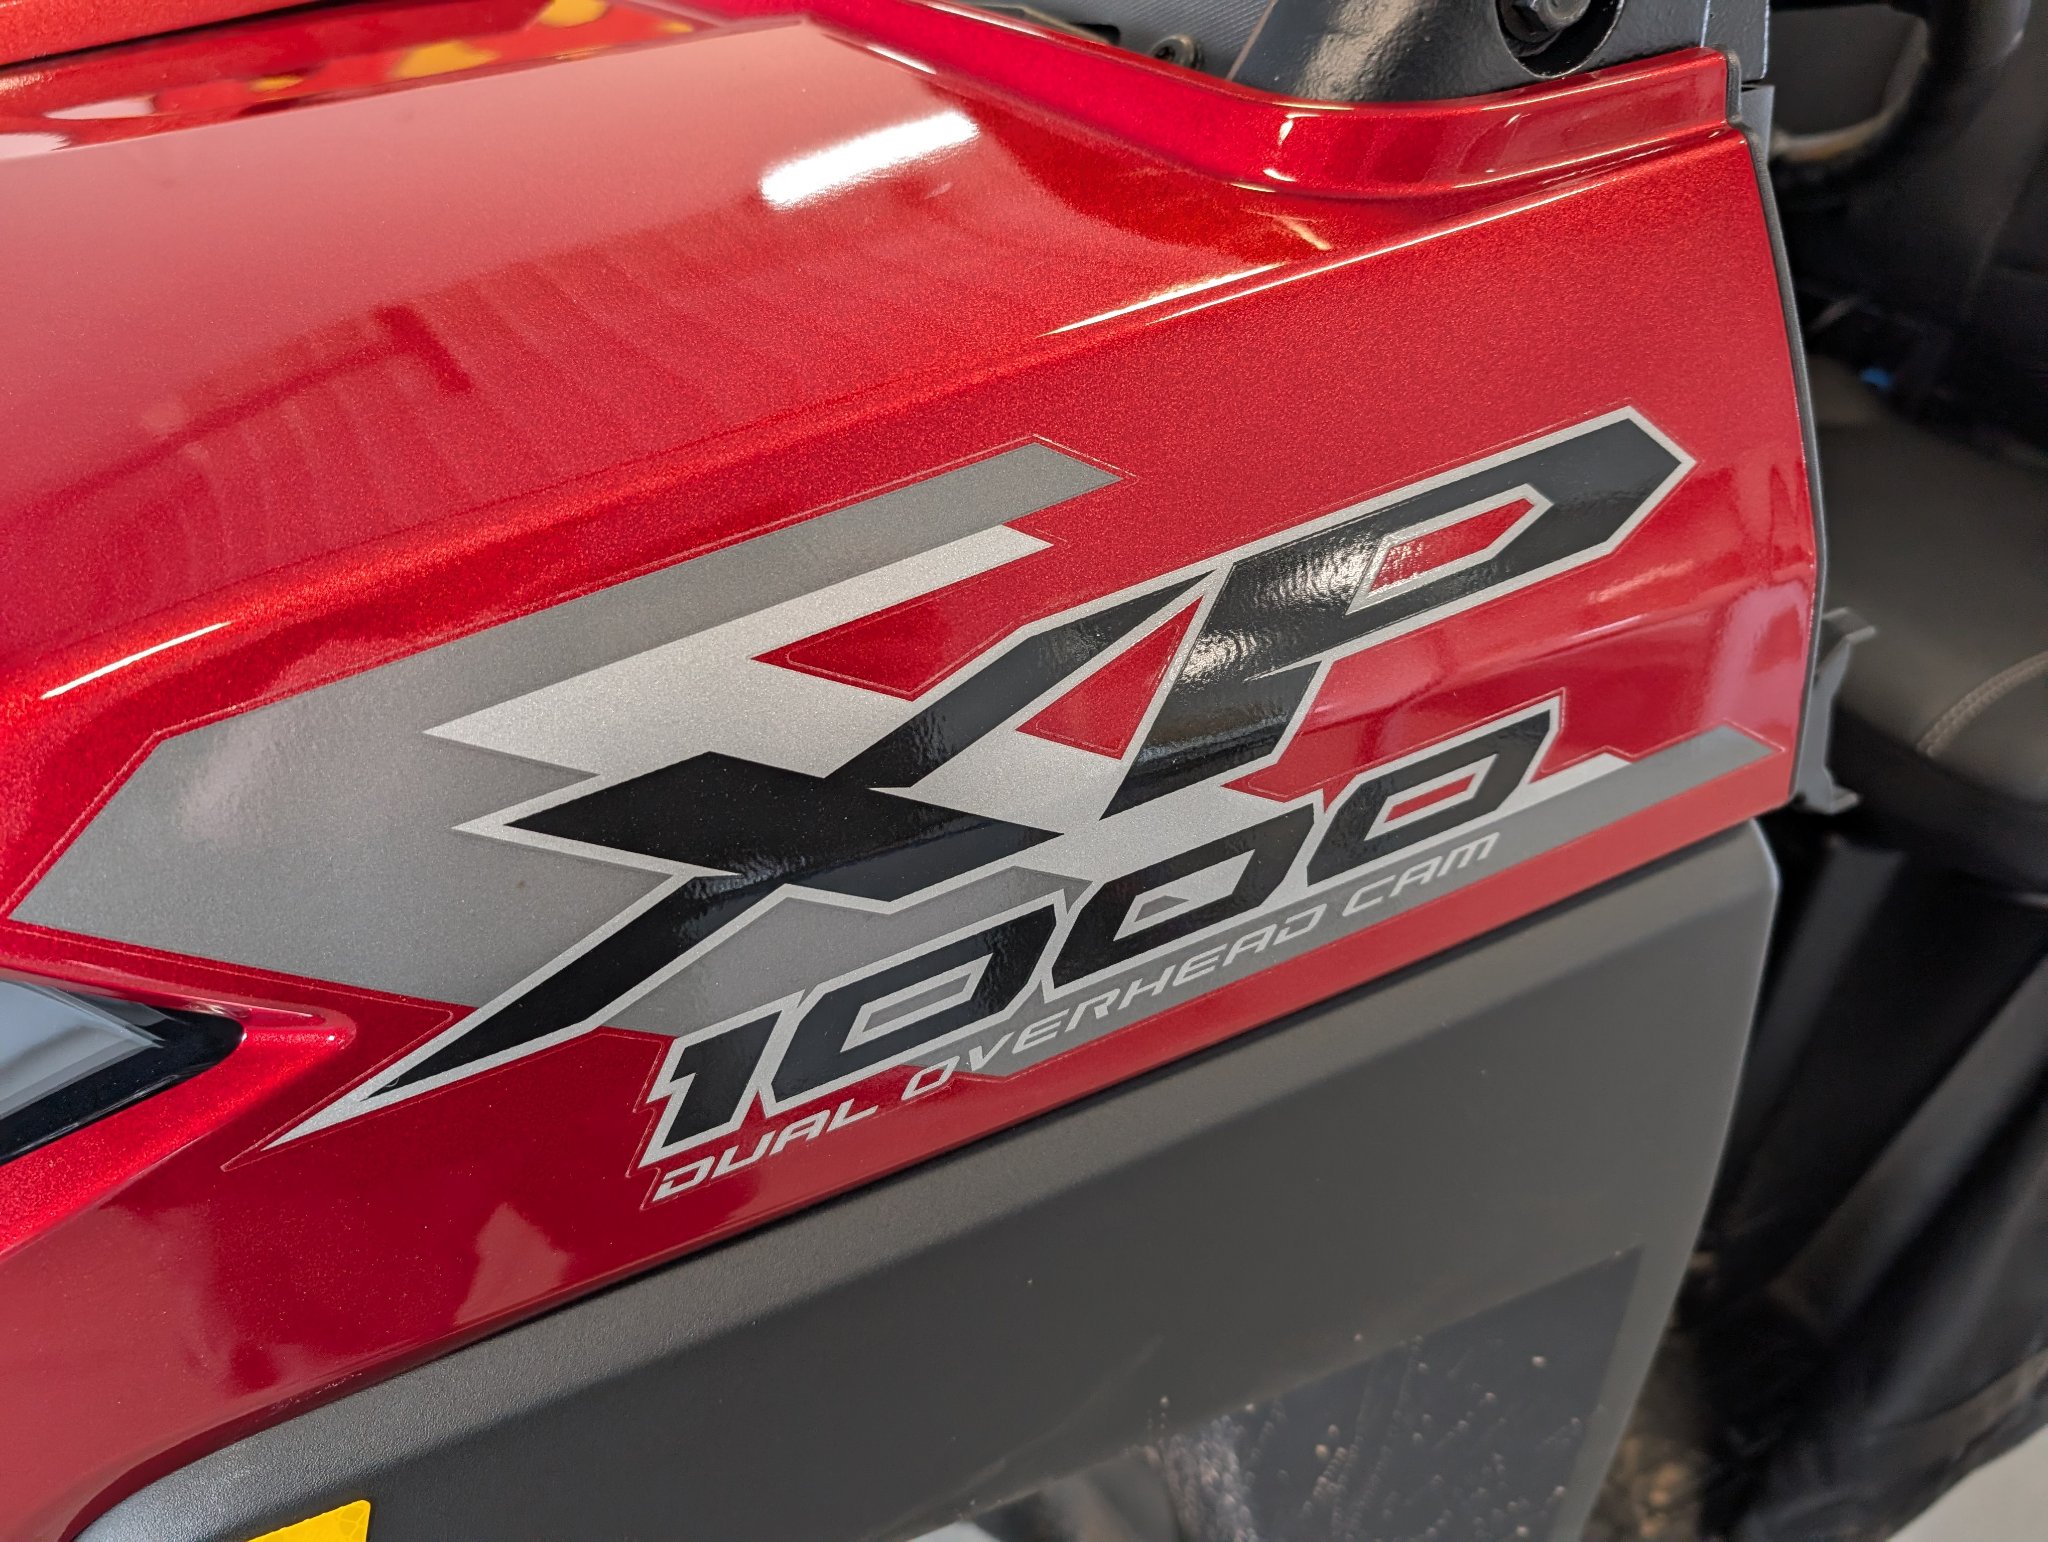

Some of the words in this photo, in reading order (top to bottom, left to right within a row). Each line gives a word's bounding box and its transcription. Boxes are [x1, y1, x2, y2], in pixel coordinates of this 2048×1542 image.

[350, 407, 1696, 1108] XP
[643, 692, 1563, 1167] 1000
[653, 1099, 879, 1202] DUAL
[902, 903, 1328, 1100] OVERHEAD
[1342, 831, 1500, 915] CAM
